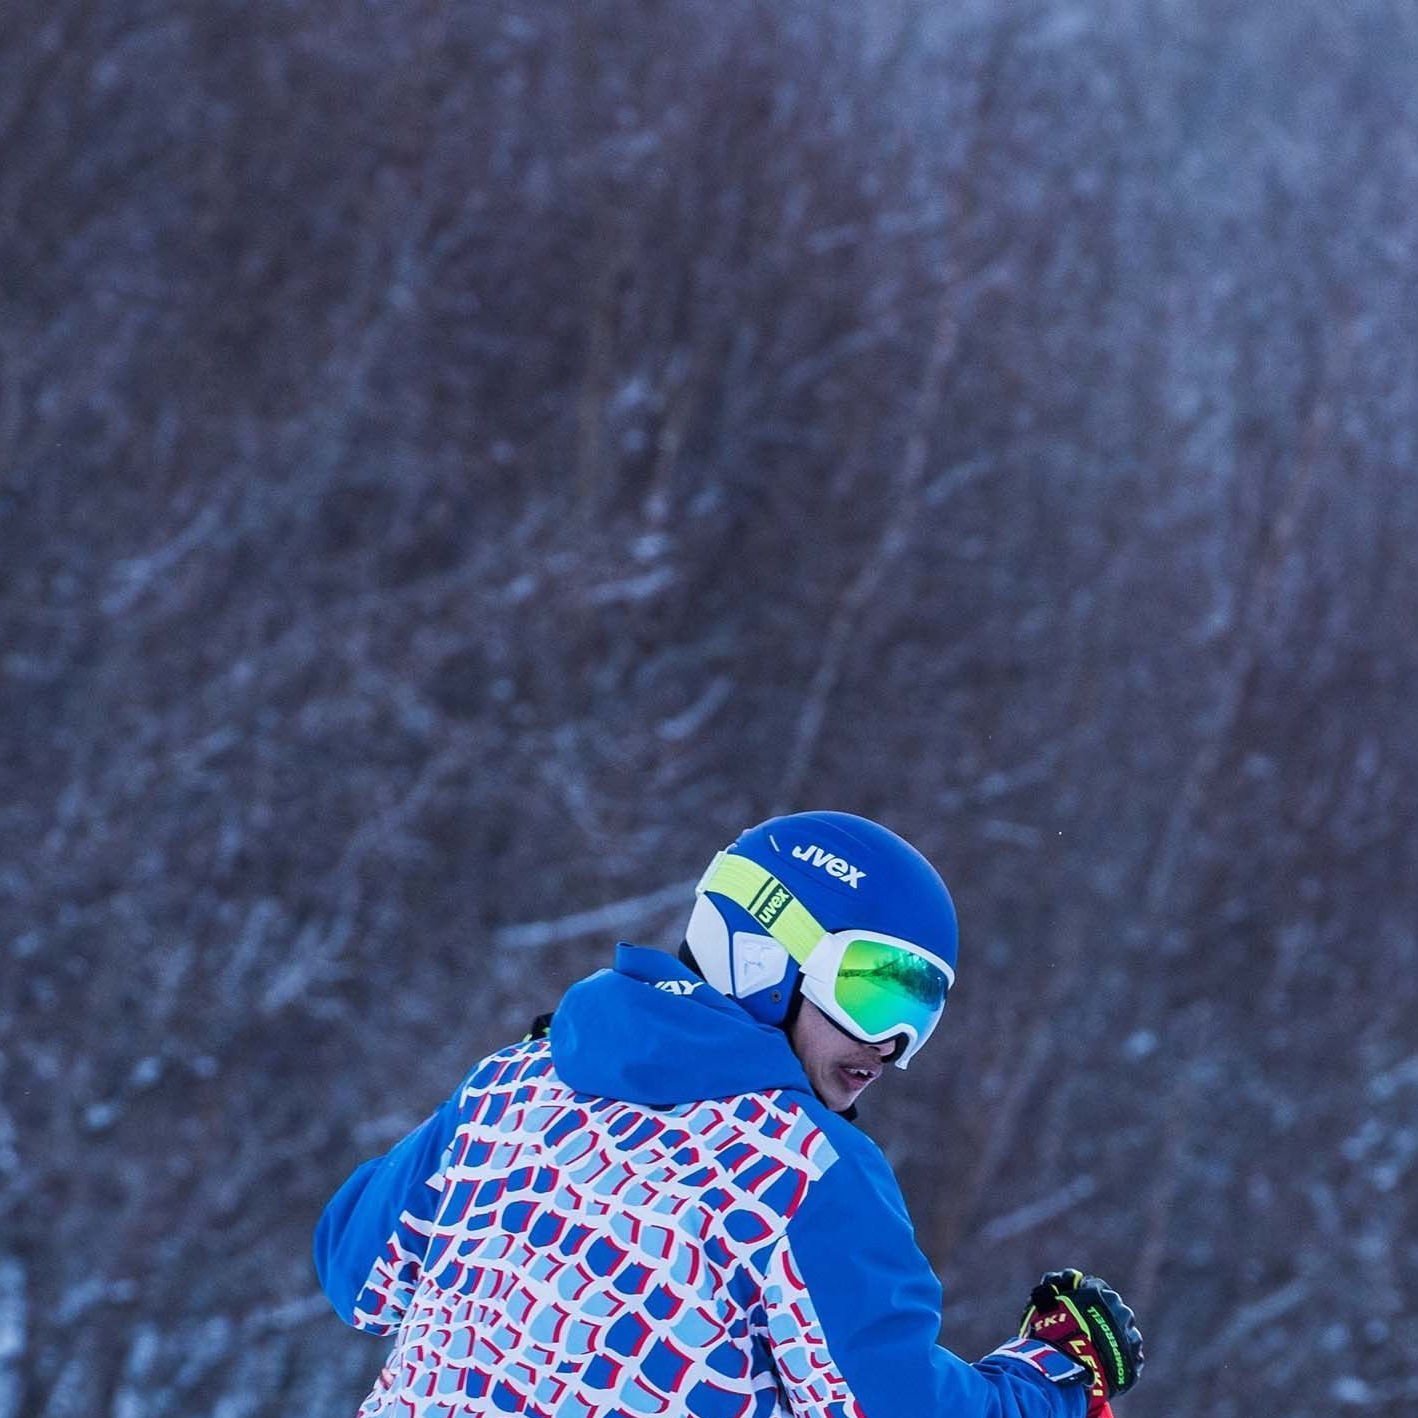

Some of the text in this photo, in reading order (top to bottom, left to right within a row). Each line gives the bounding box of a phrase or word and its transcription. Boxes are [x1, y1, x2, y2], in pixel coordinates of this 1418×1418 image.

[758, 887, 790, 924] uvex
[1034, 1312, 1067, 1332] EKI
[1087, 1305, 1125, 1385] KOMPERDELL
[1068, 1339, 1104, 1396] LEKI
